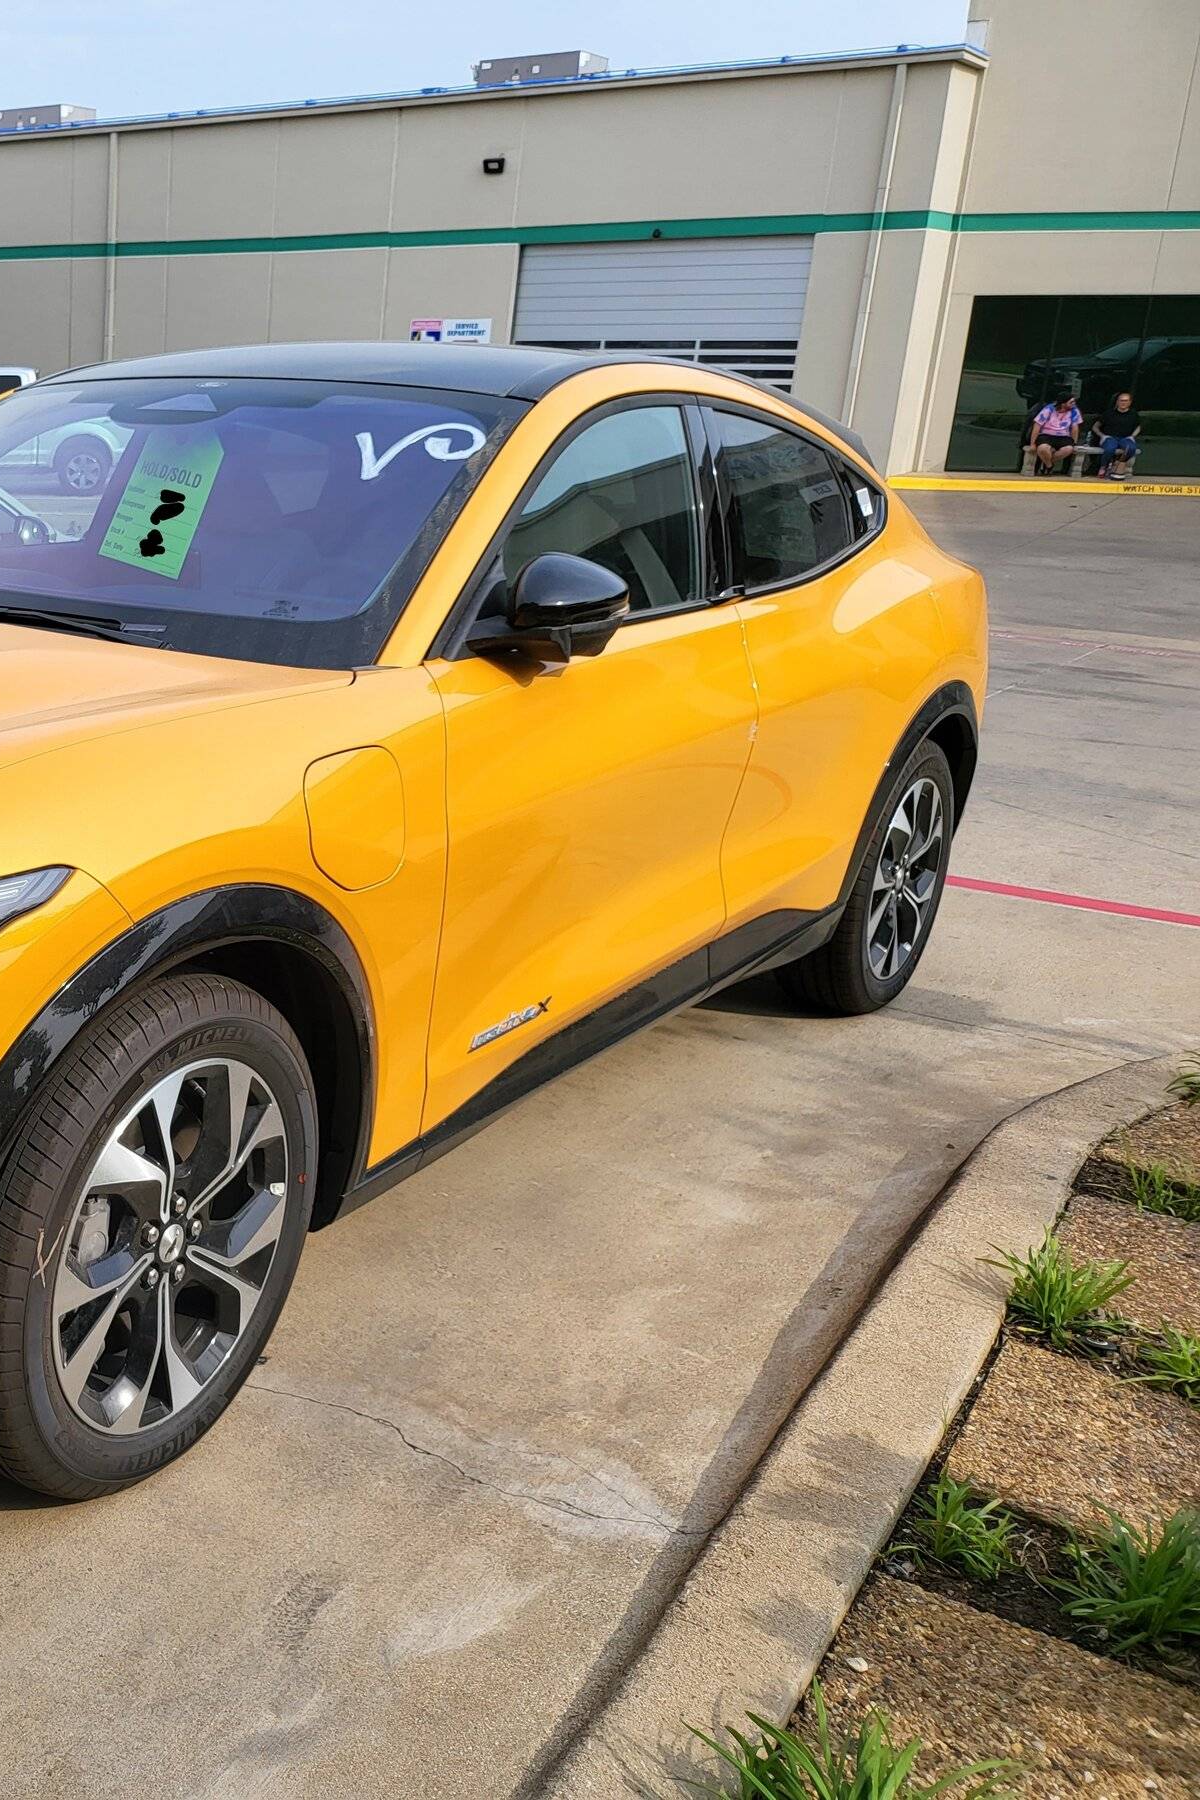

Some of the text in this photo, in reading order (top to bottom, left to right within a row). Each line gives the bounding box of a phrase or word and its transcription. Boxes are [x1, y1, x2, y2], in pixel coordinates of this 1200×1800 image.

[139, 461, 202, 488] HOLD/SOLD
[1122, 485, 1154, 493] WATCH
[1160, 486, 1182, 494] YOUR
